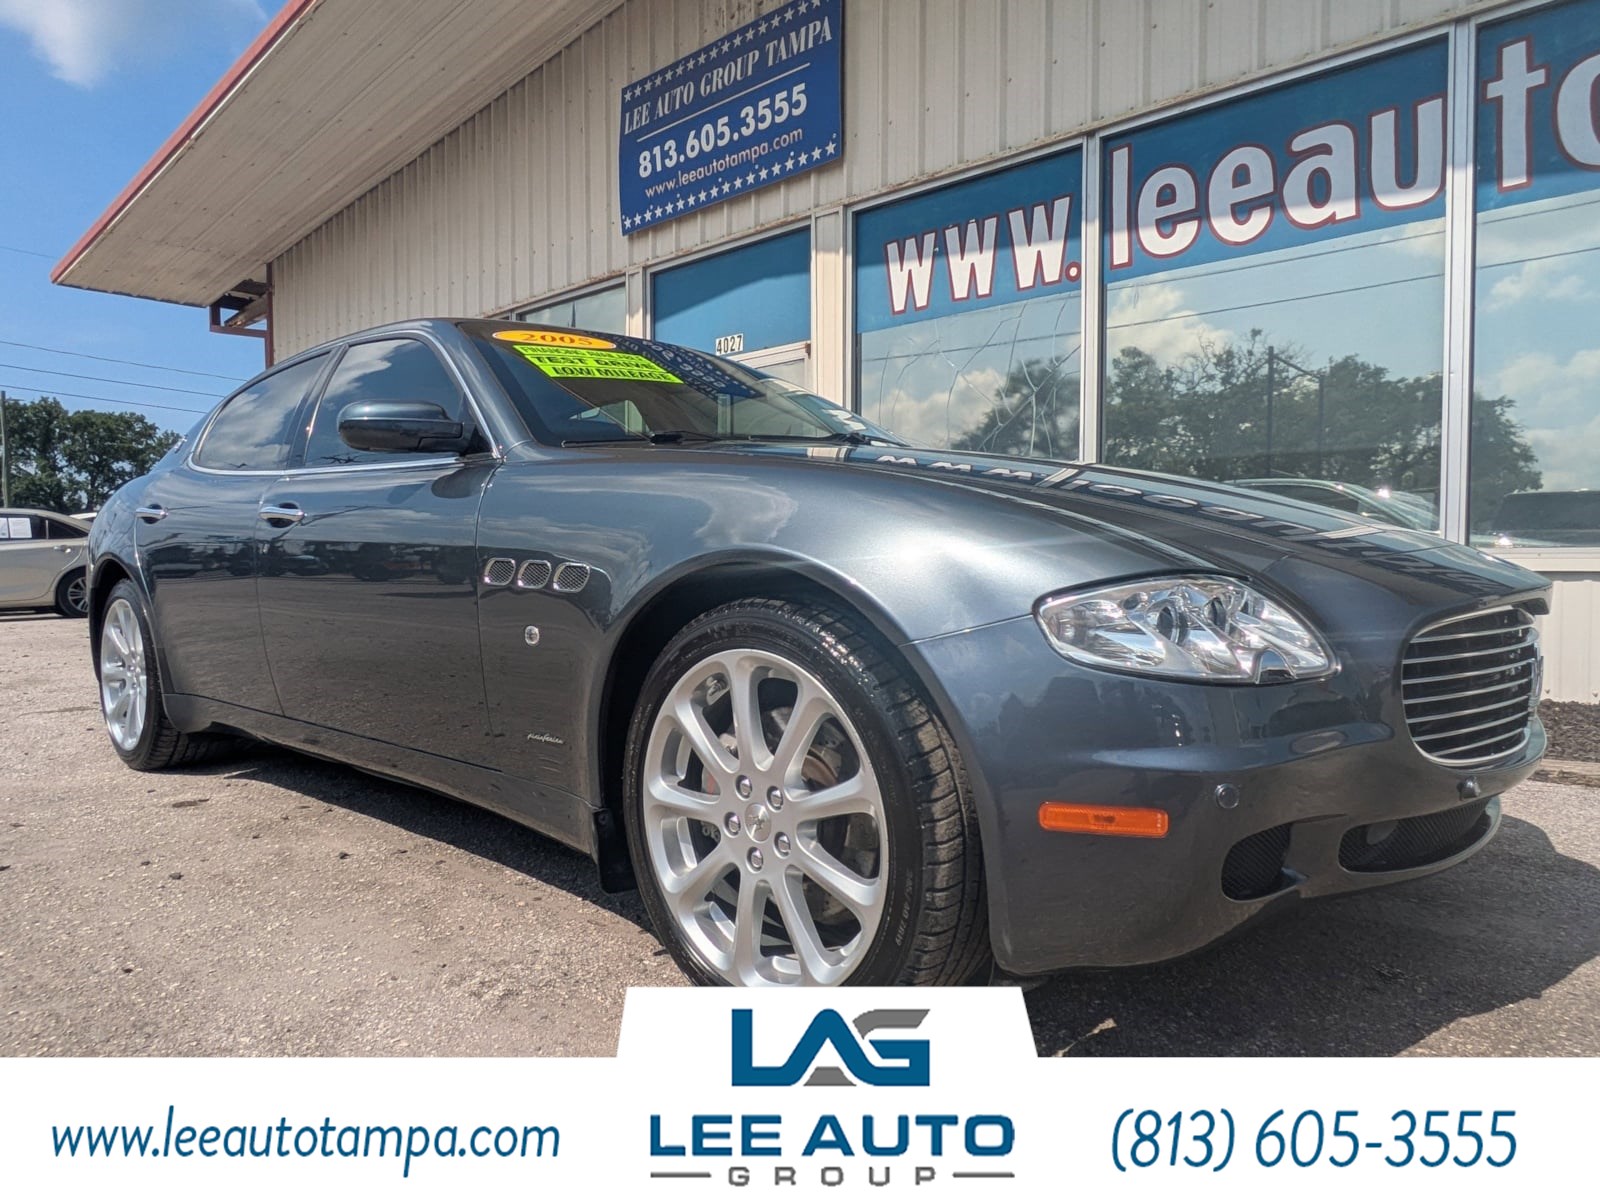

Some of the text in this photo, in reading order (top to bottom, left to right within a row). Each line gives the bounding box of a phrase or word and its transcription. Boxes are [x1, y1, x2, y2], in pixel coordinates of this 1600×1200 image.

[623, 16, 833, 136] LEE AUTO GROUP TAMPA
[638, 82, 808, 179] 813.605.3555
[644, 127, 804, 199] www.leeautotampa.com
[519, 333, 593, 346] 2005
[716, 334, 742, 355] 4027
[530, 356, 587, 365] TEST
[593, 359, 658, 371] DRIVE
[551, 366, 674, 381] LOW MILEAGE
